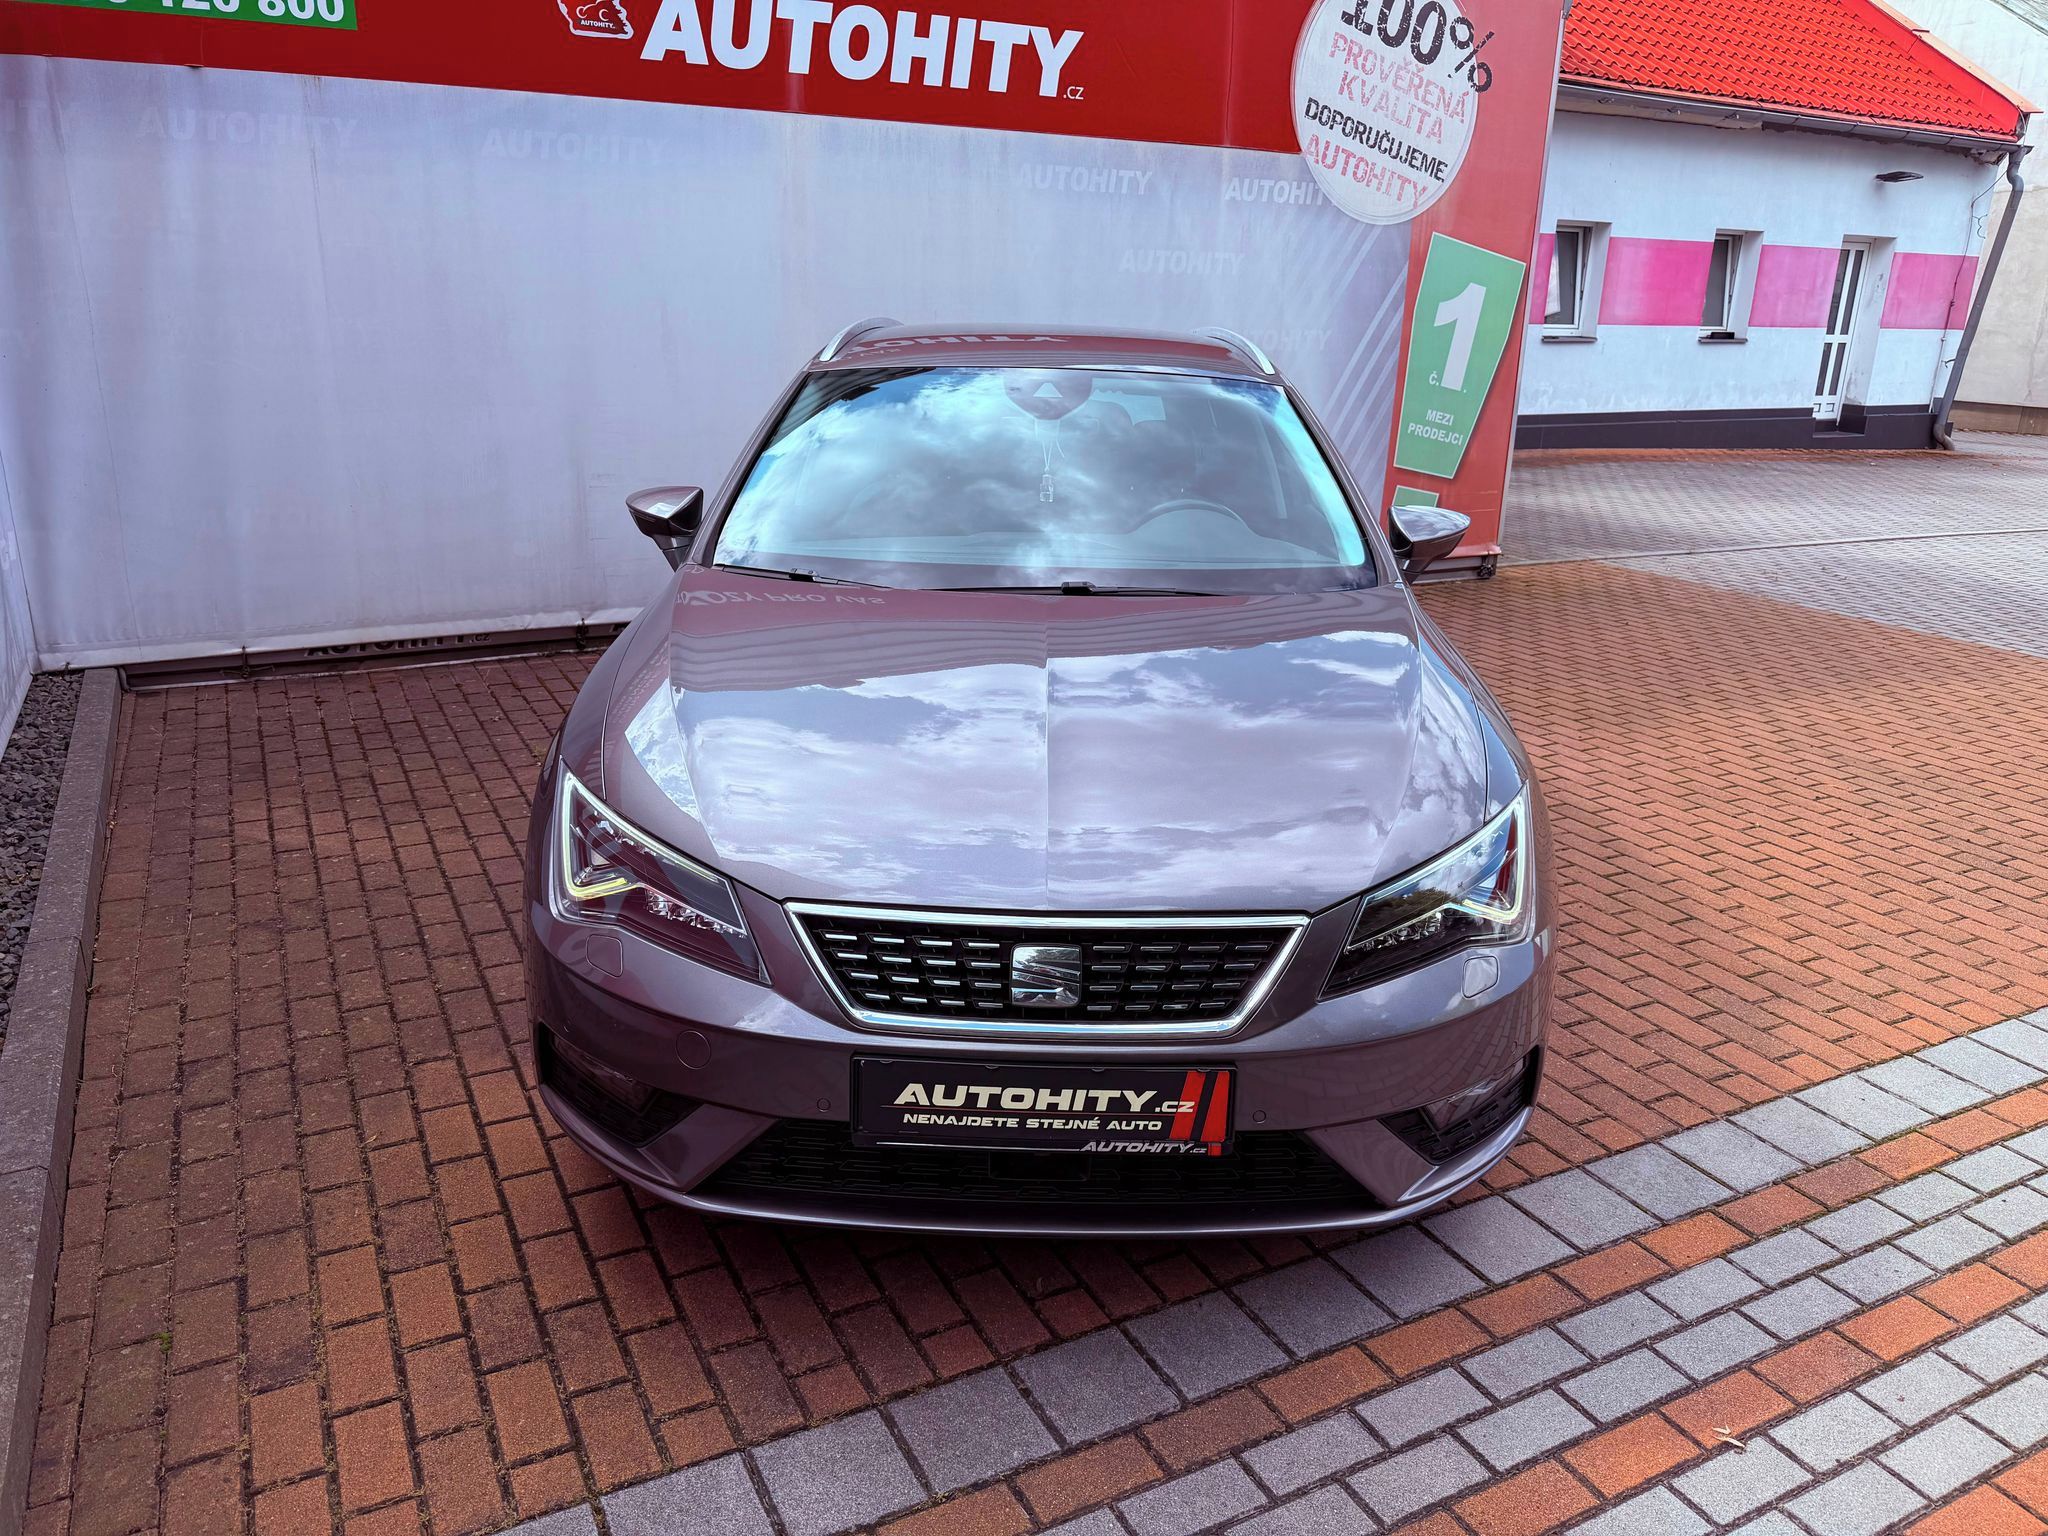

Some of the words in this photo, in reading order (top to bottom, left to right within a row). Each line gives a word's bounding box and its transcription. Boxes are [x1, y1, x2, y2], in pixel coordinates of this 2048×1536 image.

[1341, 0, 1494, 93] 100%
[1329, 31, 1470, 124] PROVĚŘENÁ
[1338, 70, 1443, 144] KVALITA
[137, 107, 358, 151] AUTOHITY
[481, 127, 670, 166] AUTOHITY
[1304, 97, 1448, 182] DOPORUČUJEME
[1017, 164, 1153, 196] AUTOHITY
[1304, 133, 1428, 209] AUTOHITY
[1224, 177, 1335, 206] AUTOHIT
[1119, 249, 1246, 277] AUTOHITY
[1408, 423, 1464, 446] PRODEJCI
[1425, 409, 1454, 426] MEZI
[903, 1113, 1019, 1128] NENAJDETE
[1025, 1117, 1100, 1130] STEJNÉ
[1106, 1119, 1162, 1131] AUTO
